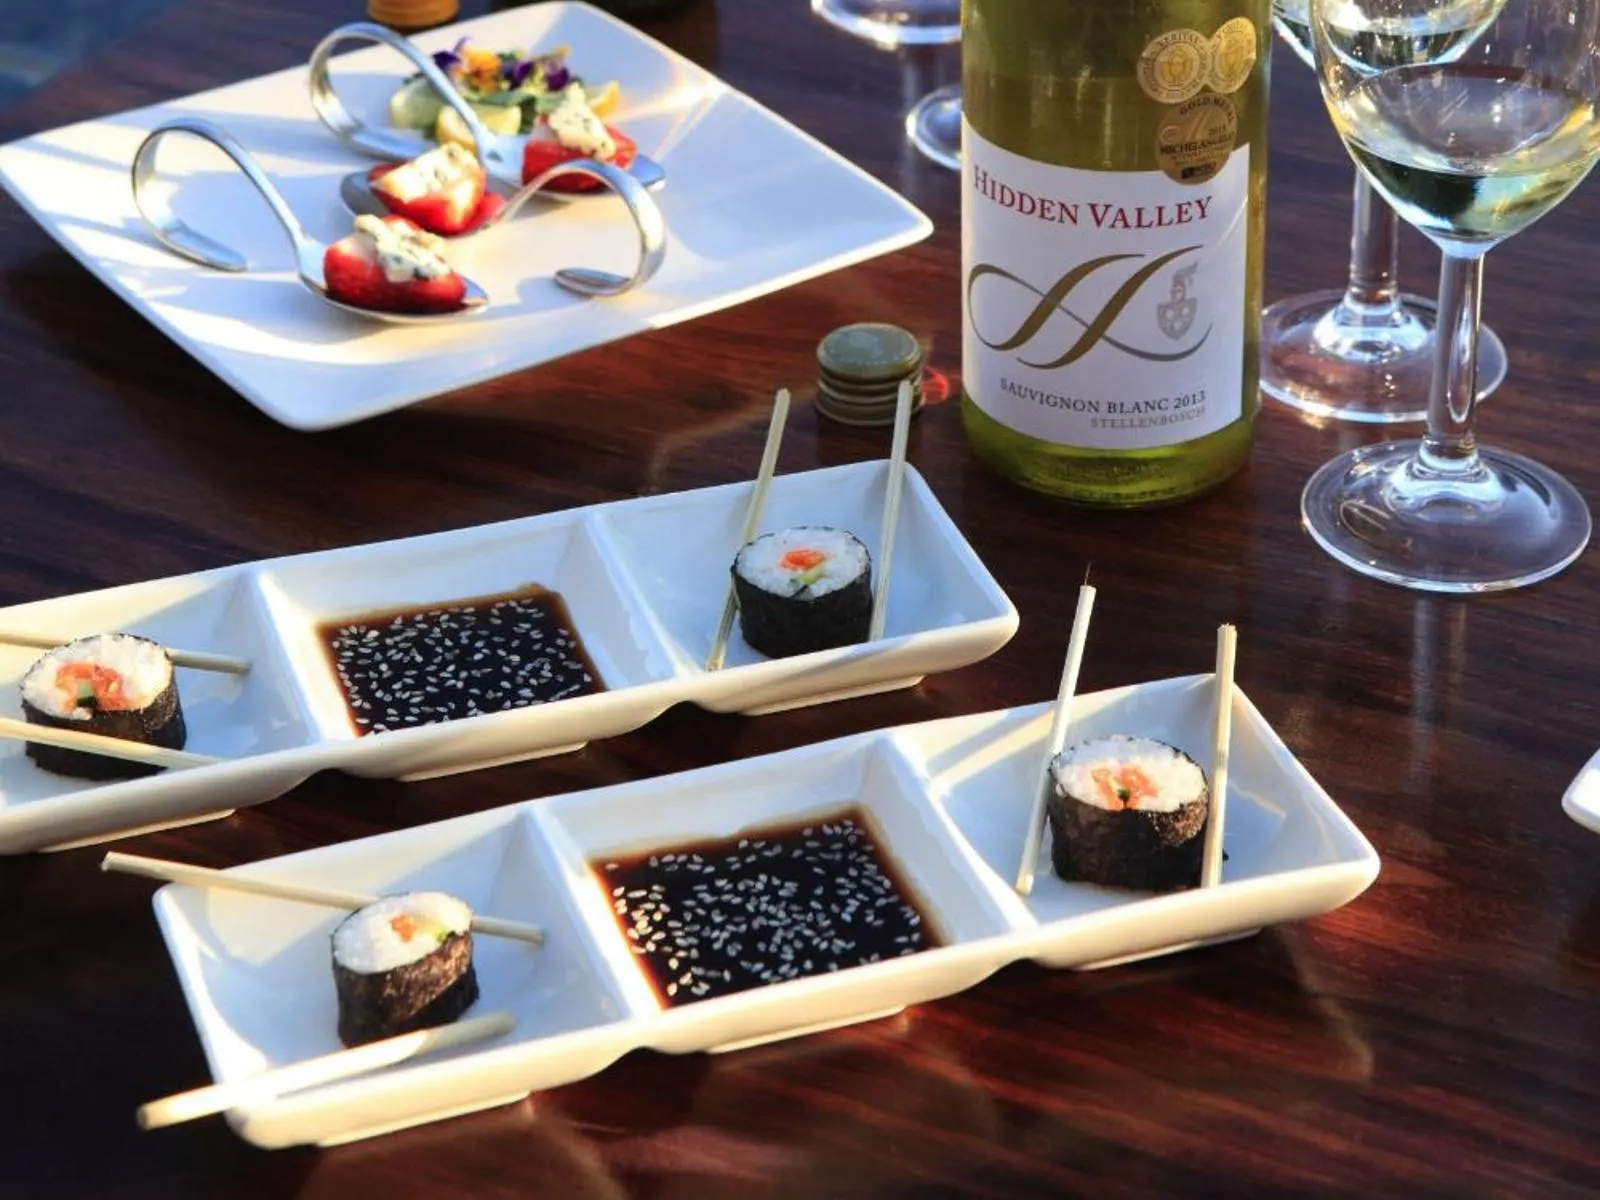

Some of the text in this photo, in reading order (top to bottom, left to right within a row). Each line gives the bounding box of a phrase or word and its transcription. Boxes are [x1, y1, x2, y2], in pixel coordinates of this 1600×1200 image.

[974, 164, 1213, 229] HIDDEN VALLEY
[1000, 377, 1206, 414] SAUVIGNON BLANC 2013
[1091, 406, 1206, 429] STELLENBOSCH
